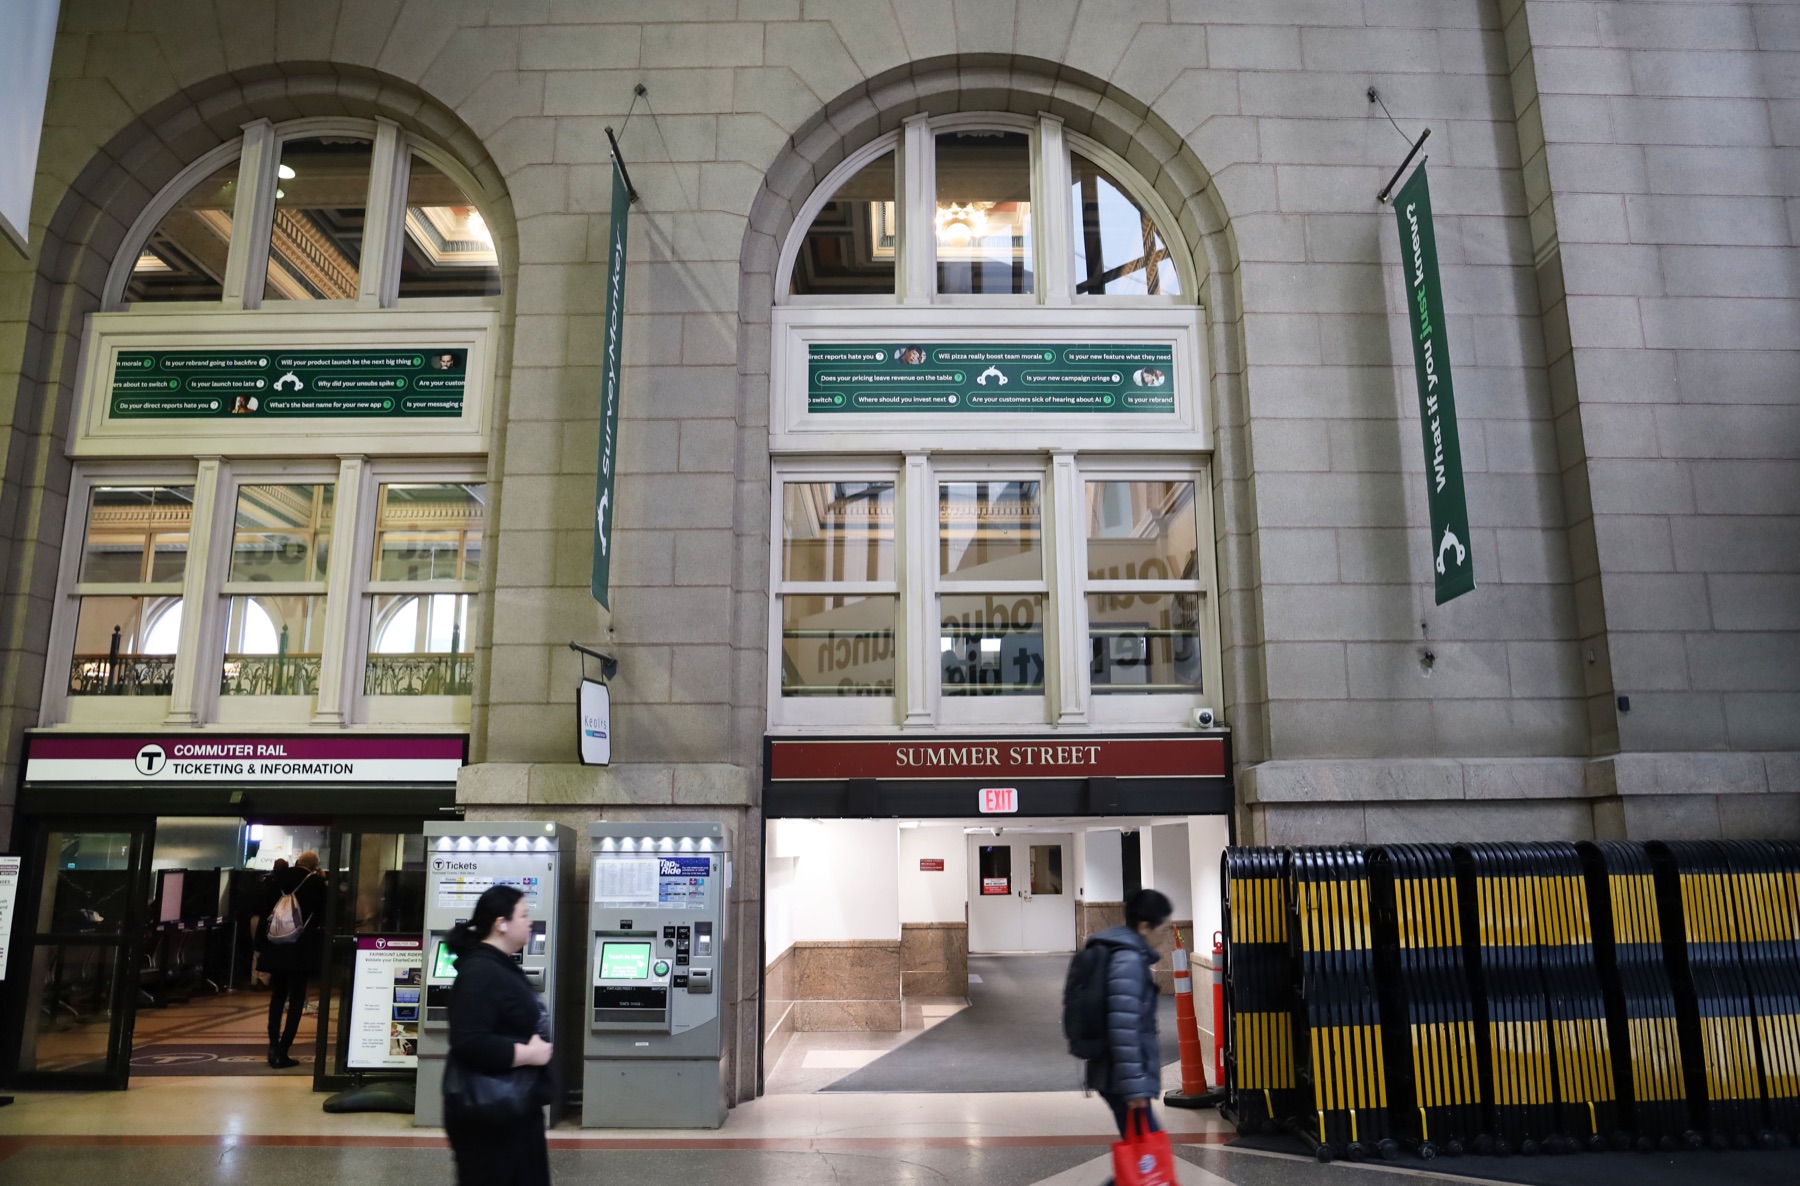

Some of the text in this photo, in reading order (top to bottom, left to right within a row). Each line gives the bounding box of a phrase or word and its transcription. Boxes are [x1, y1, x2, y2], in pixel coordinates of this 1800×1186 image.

[1406, 202, 1446, 494] What if you just knew?
[602, 230, 622, 479] SurveyMonkey
[852, 374, 874, 382] pricing
[427, 400, 459, 409] messaging
[584, 714, 606, 730] Keolis
[174, 744, 288, 756] COMMUTER RAIL
[895, 746, 1101, 766] SUMMER STREET
[172, 763, 353, 775] TICKETING & INFORMATION
[985, 790, 1012, 812] EXIT
[446, 861, 478, 870] Tickets
[660, 859, 676, 868] Tap
[660, 866, 682, 875] Ride
